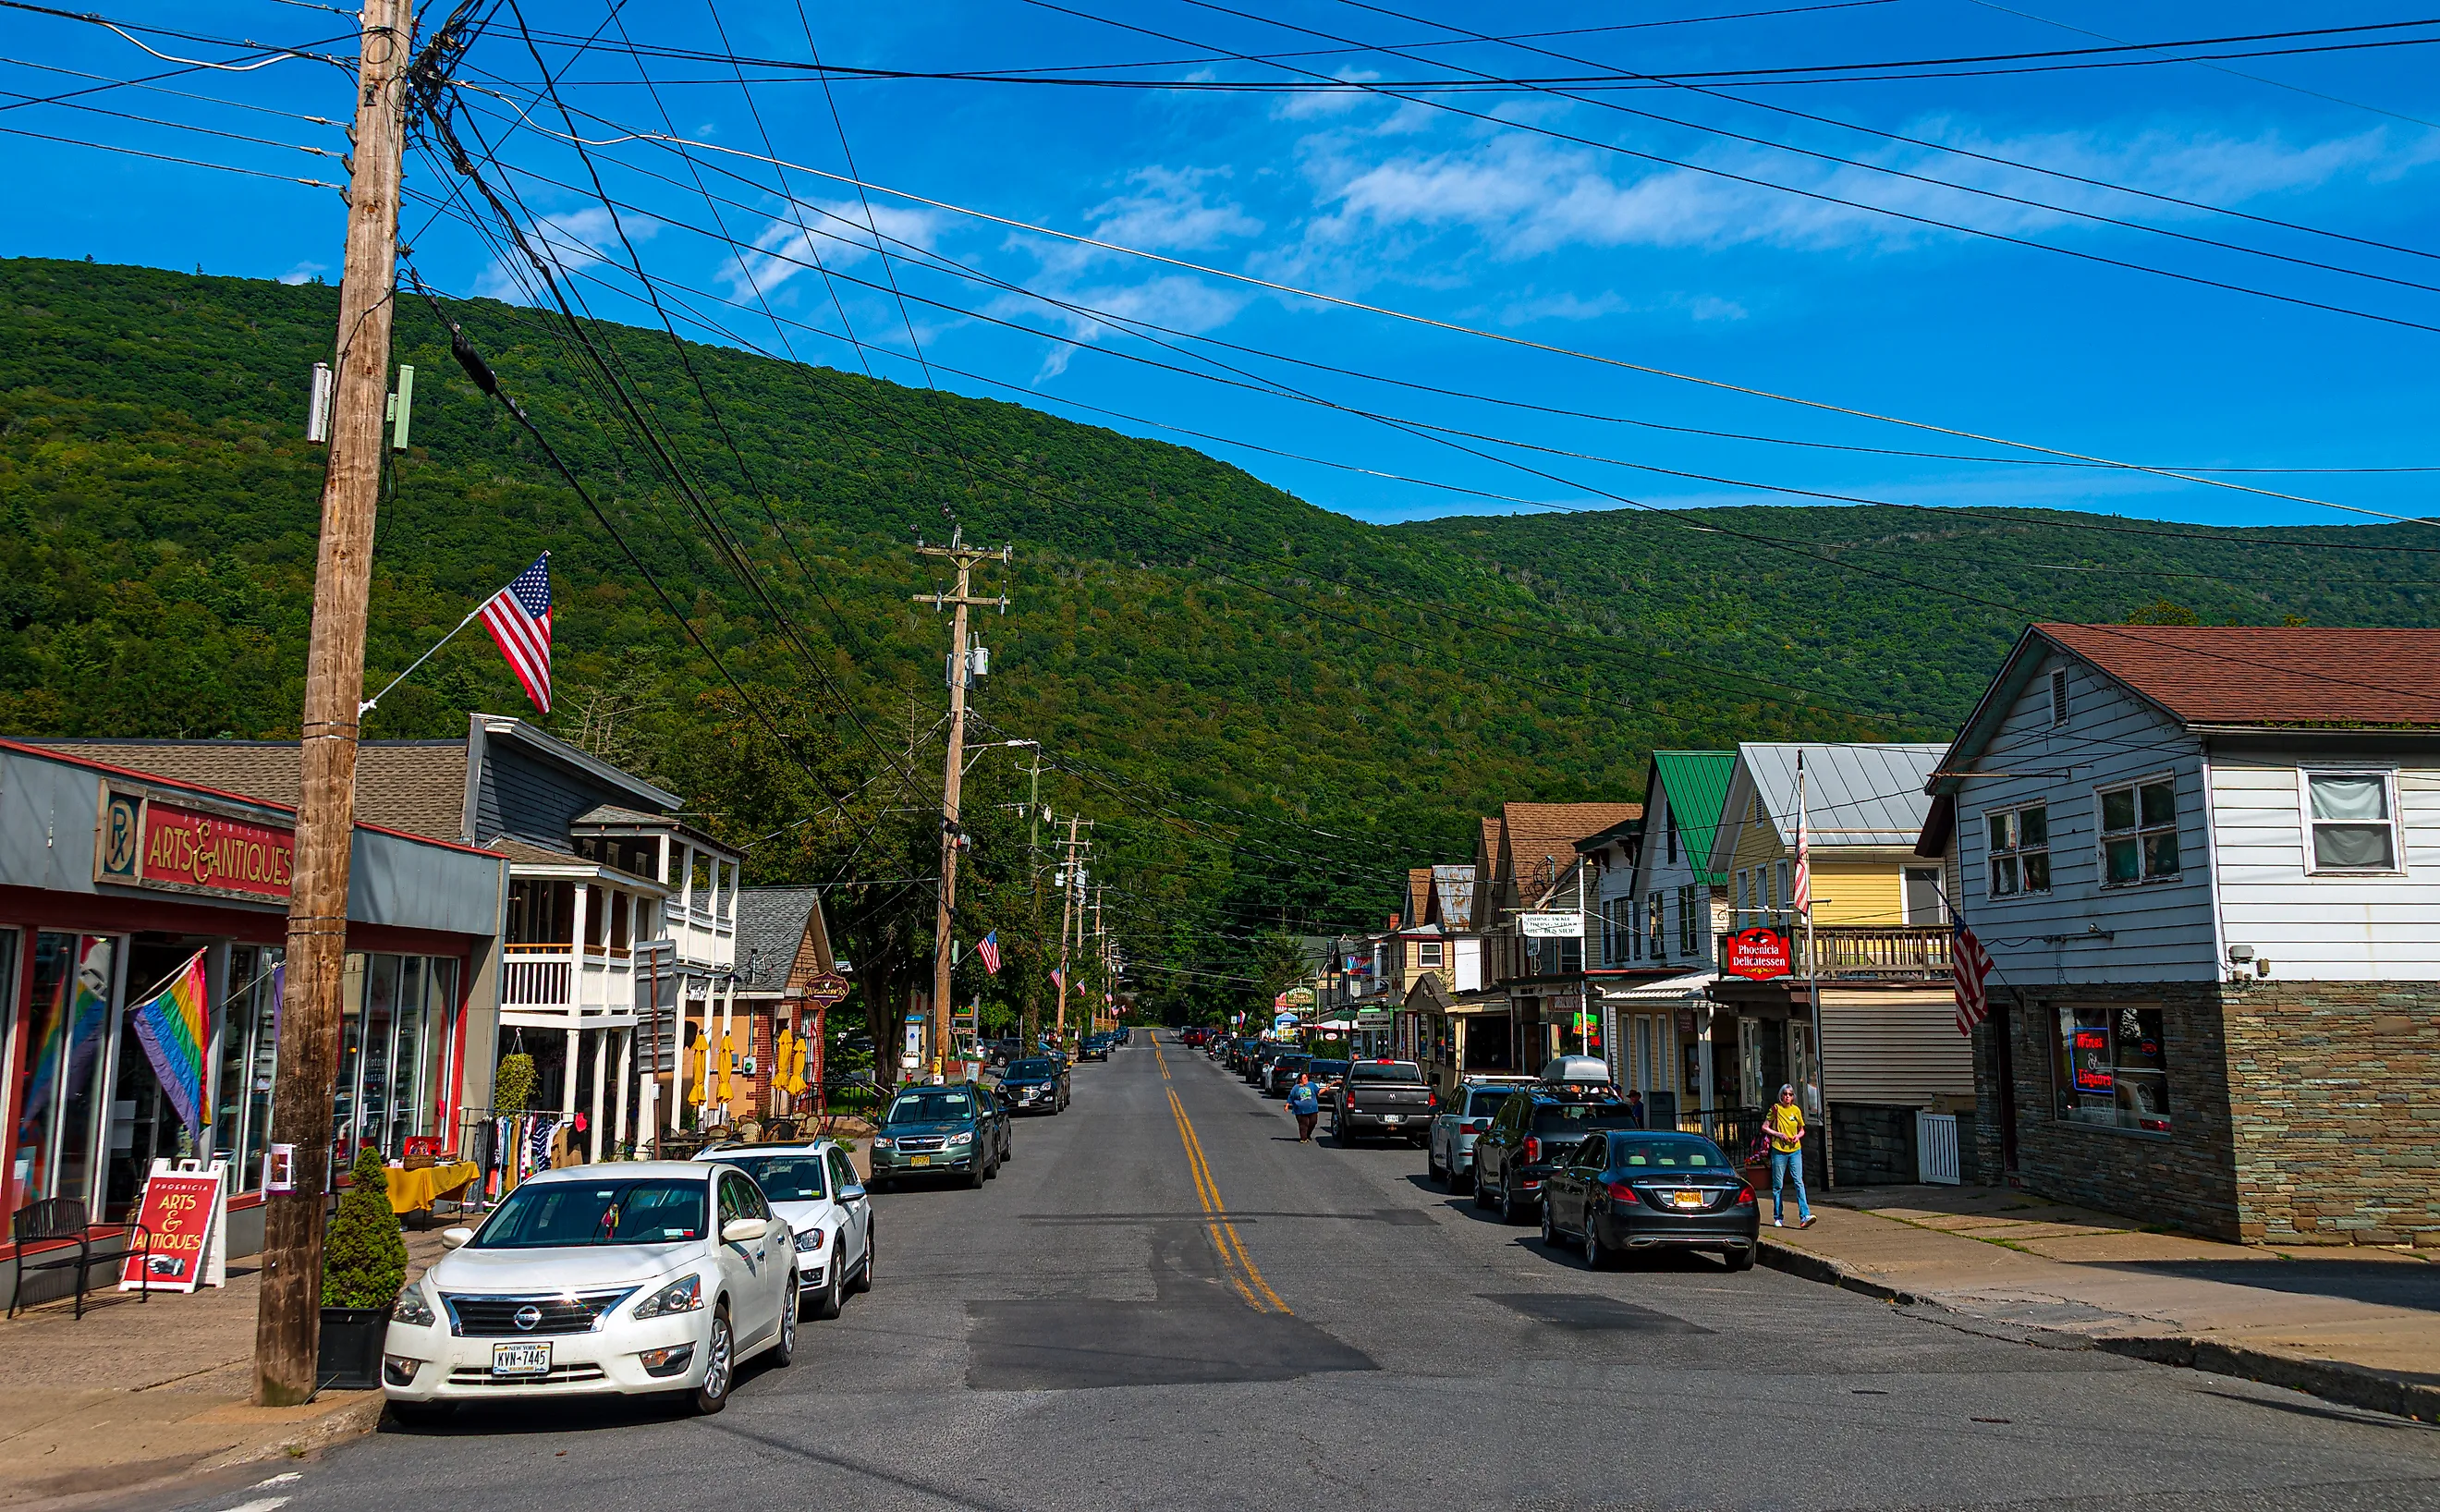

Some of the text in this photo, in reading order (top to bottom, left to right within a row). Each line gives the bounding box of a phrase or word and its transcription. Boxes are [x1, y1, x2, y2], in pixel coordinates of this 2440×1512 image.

[184, 813, 270, 840] PHOENICIA
[148, 822, 293, 886] ARTS & ANTIQUES
[1738, 945, 1779, 955] Phoenicia
[1733, 956, 1786, 966] Delicatessen
[2077, 1032, 2103, 1048] Wines
[2078, 1068, 2112, 1088] Liquors
[155, 1183, 208, 1191] PHOENICIA
[158, 1194, 197, 1210] ARTS
[162, 1209, 183, 1232] &
